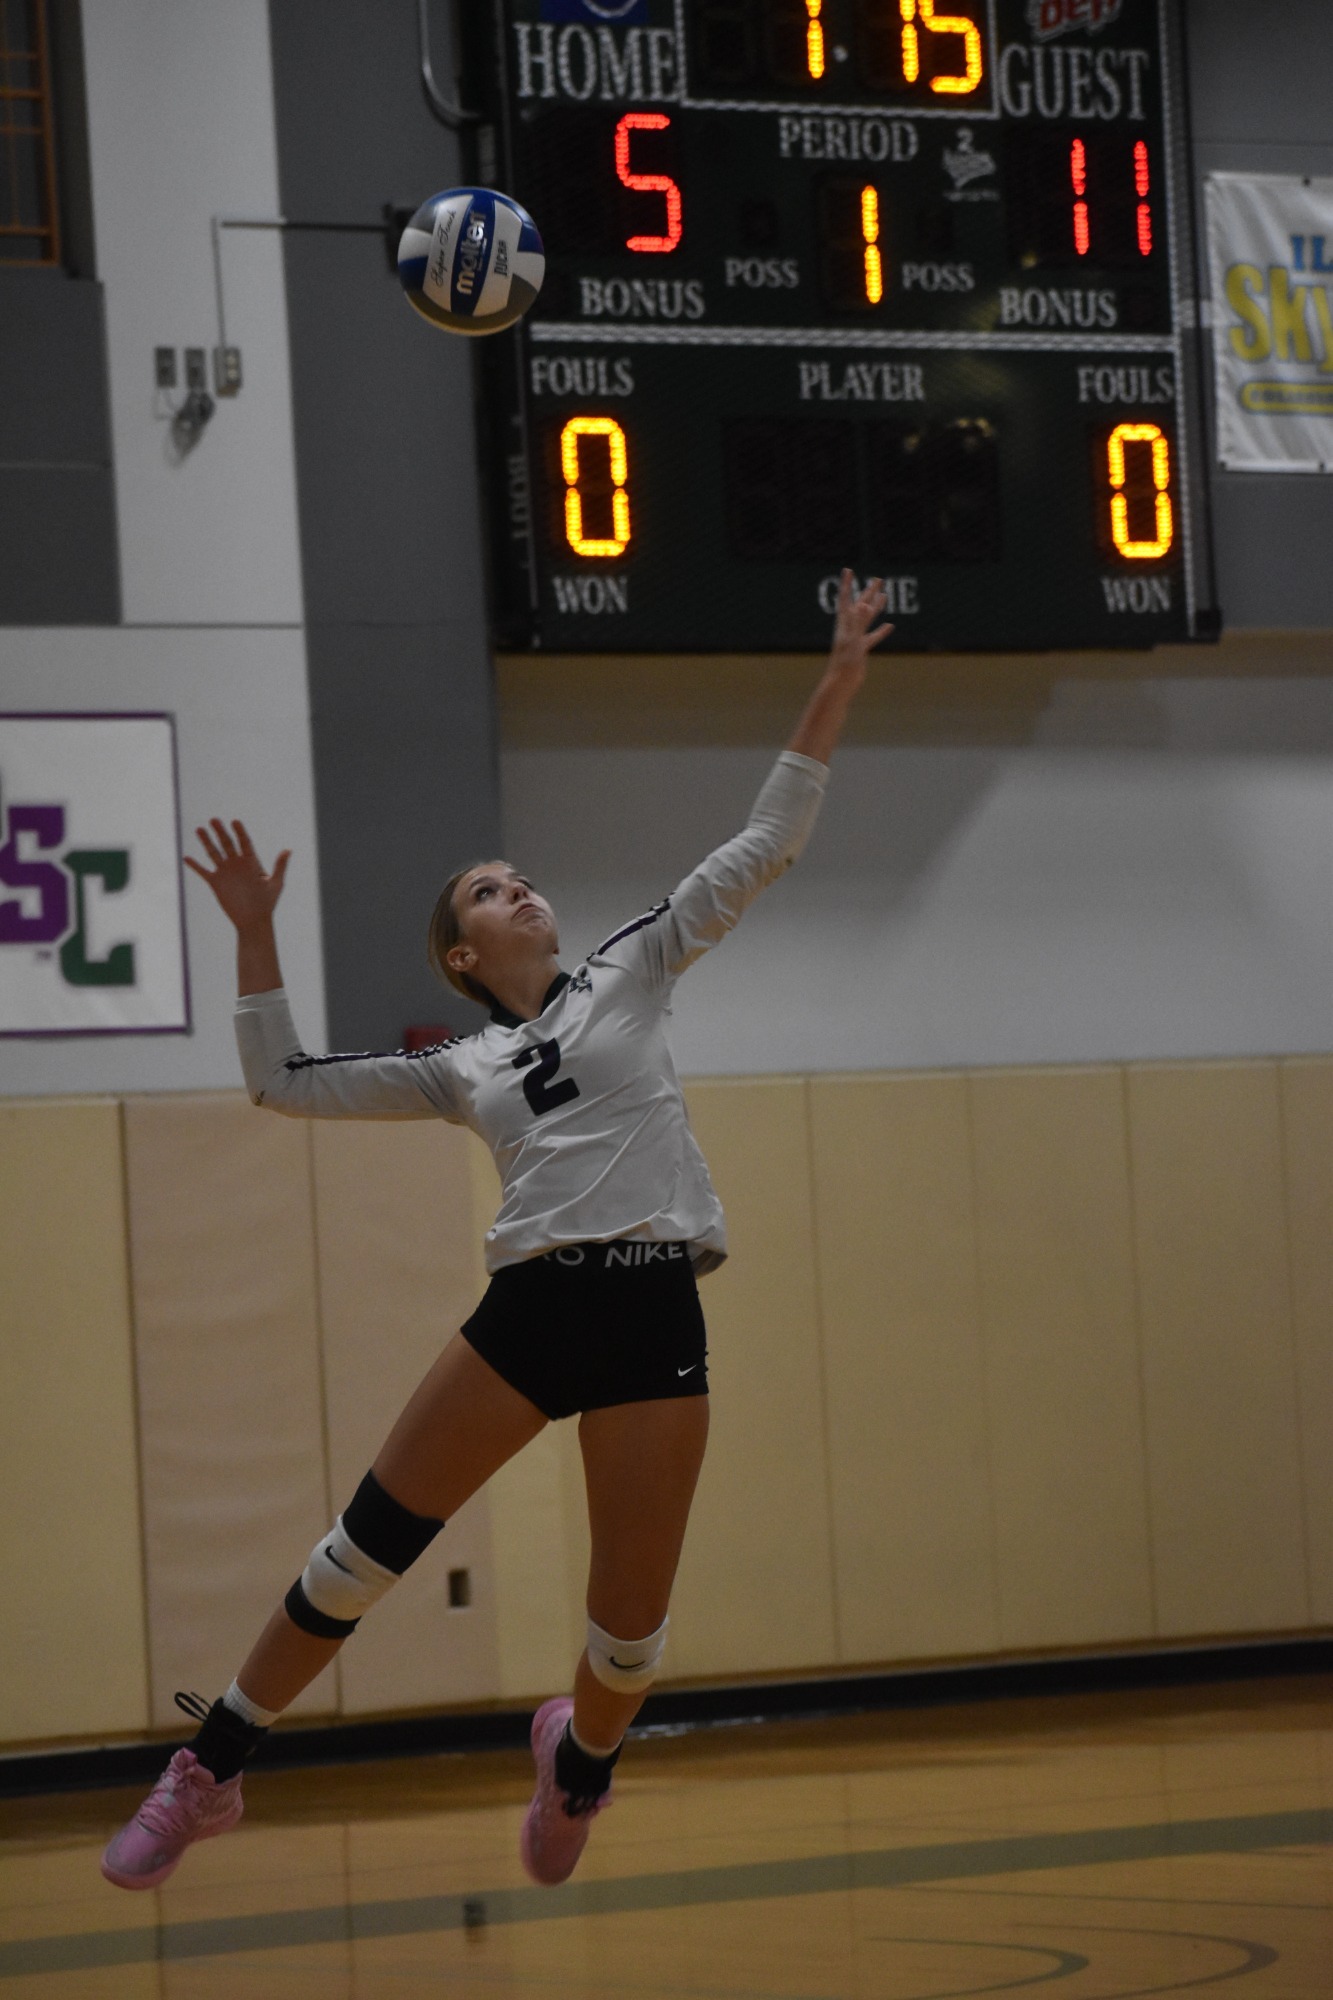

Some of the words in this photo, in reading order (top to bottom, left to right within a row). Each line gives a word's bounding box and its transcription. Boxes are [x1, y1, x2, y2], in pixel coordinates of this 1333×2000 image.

[514, 22, 674, 100] HOME
[1001, 43, 1150, 119] GUEST
[778, 116, 918, 161] PERIOD
[615, 113, 682, 252] 5
[1071, 139, 1152, 255] 11
[456, 210, 487, 295] molten
[861, 185, 882, 303] 1
[725, 258, 799, 288] POSS
[902, 263, 975, 291] POSS
[580, 277, 705, 320] BONUS
[999, 287, 1118, 327] BONUS
[530, 356, 635, 396] FOULS
[799, 361, 925, 401] PLAYER
[1077, 366, 1174, 403] FOULS
[560, 416, 631, 557] 0
[1107, 423, 1173, 558] 0
[552, 576, 628, 613] WON
[1101, 576, 1172, 613] WON
[511, 1037, 580, 1116] 2
[604, 1242, 684, 1268] NIKE
